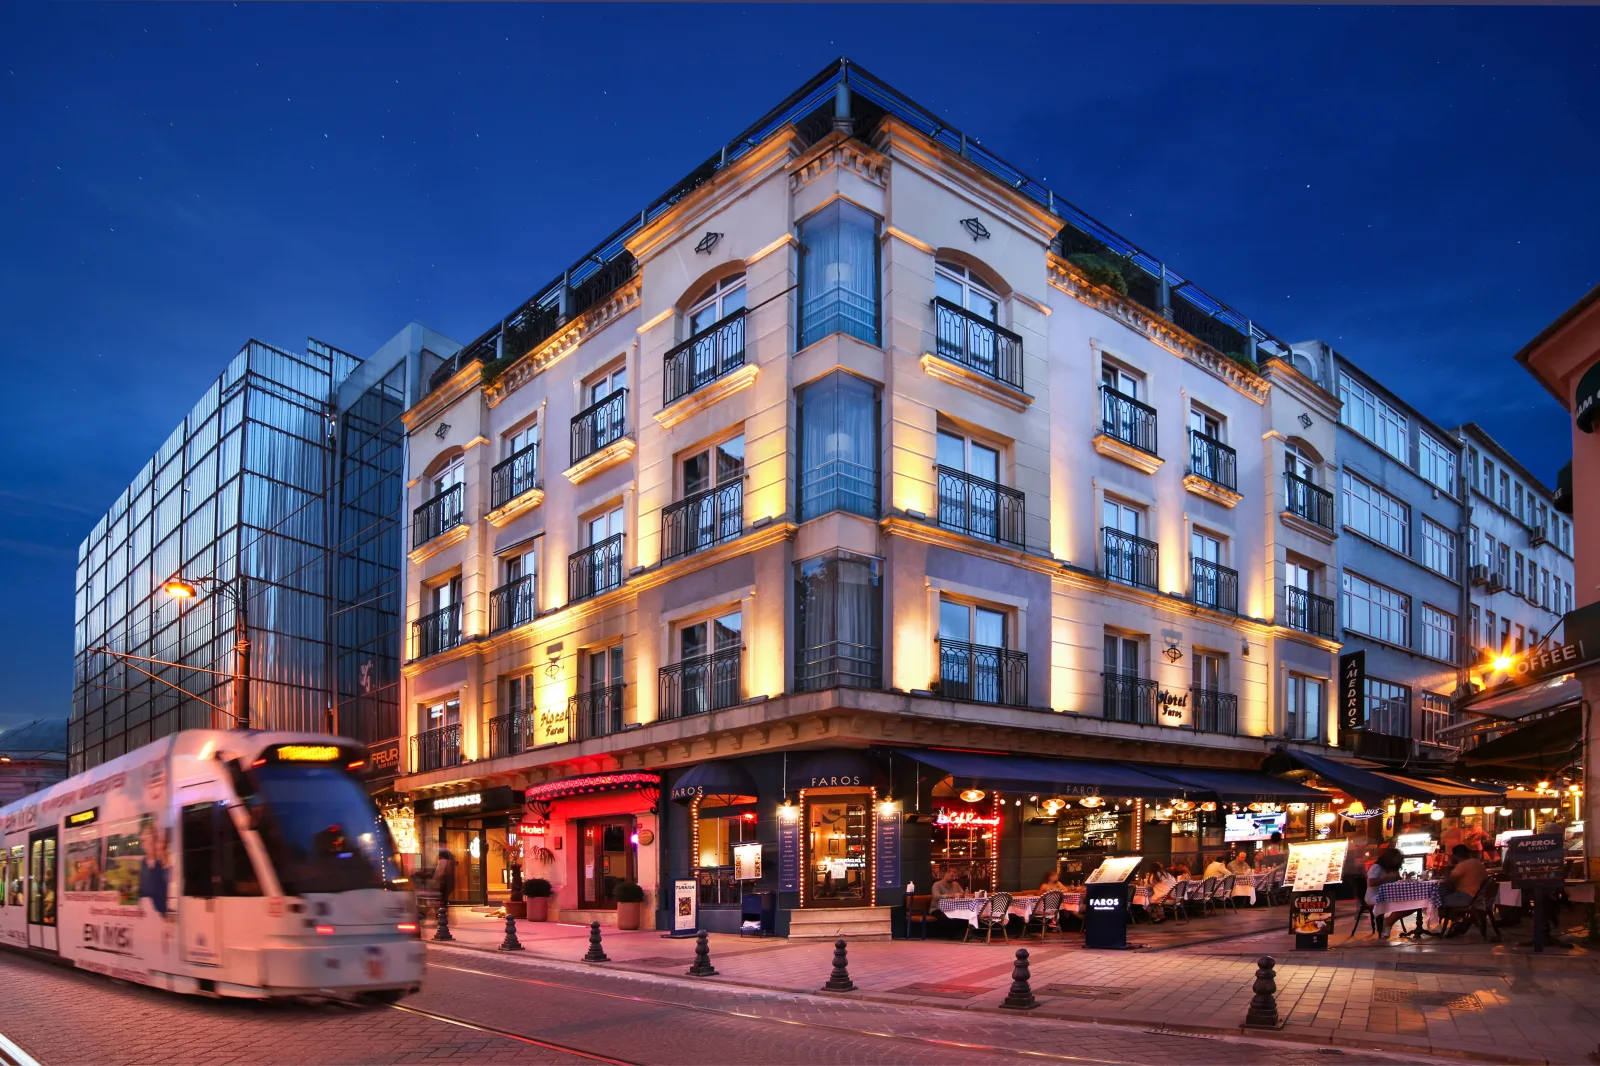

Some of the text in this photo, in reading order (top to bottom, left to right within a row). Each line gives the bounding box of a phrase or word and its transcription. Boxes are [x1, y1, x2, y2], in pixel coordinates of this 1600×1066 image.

[1507, 644, 1577, 678] OFFEE
[1346, 659, 1358, 727] AMEDROS
[811, 776, 860, 787] FAROS
[671, 786, 703, 799] FAROS
[1066, 785, 1100, 796] FAROS
[434, 794, 481, 810] STARBUCKS
[520, 825, 545, 834] Hotel
[1518, 839, 1557, 847] APEROL
